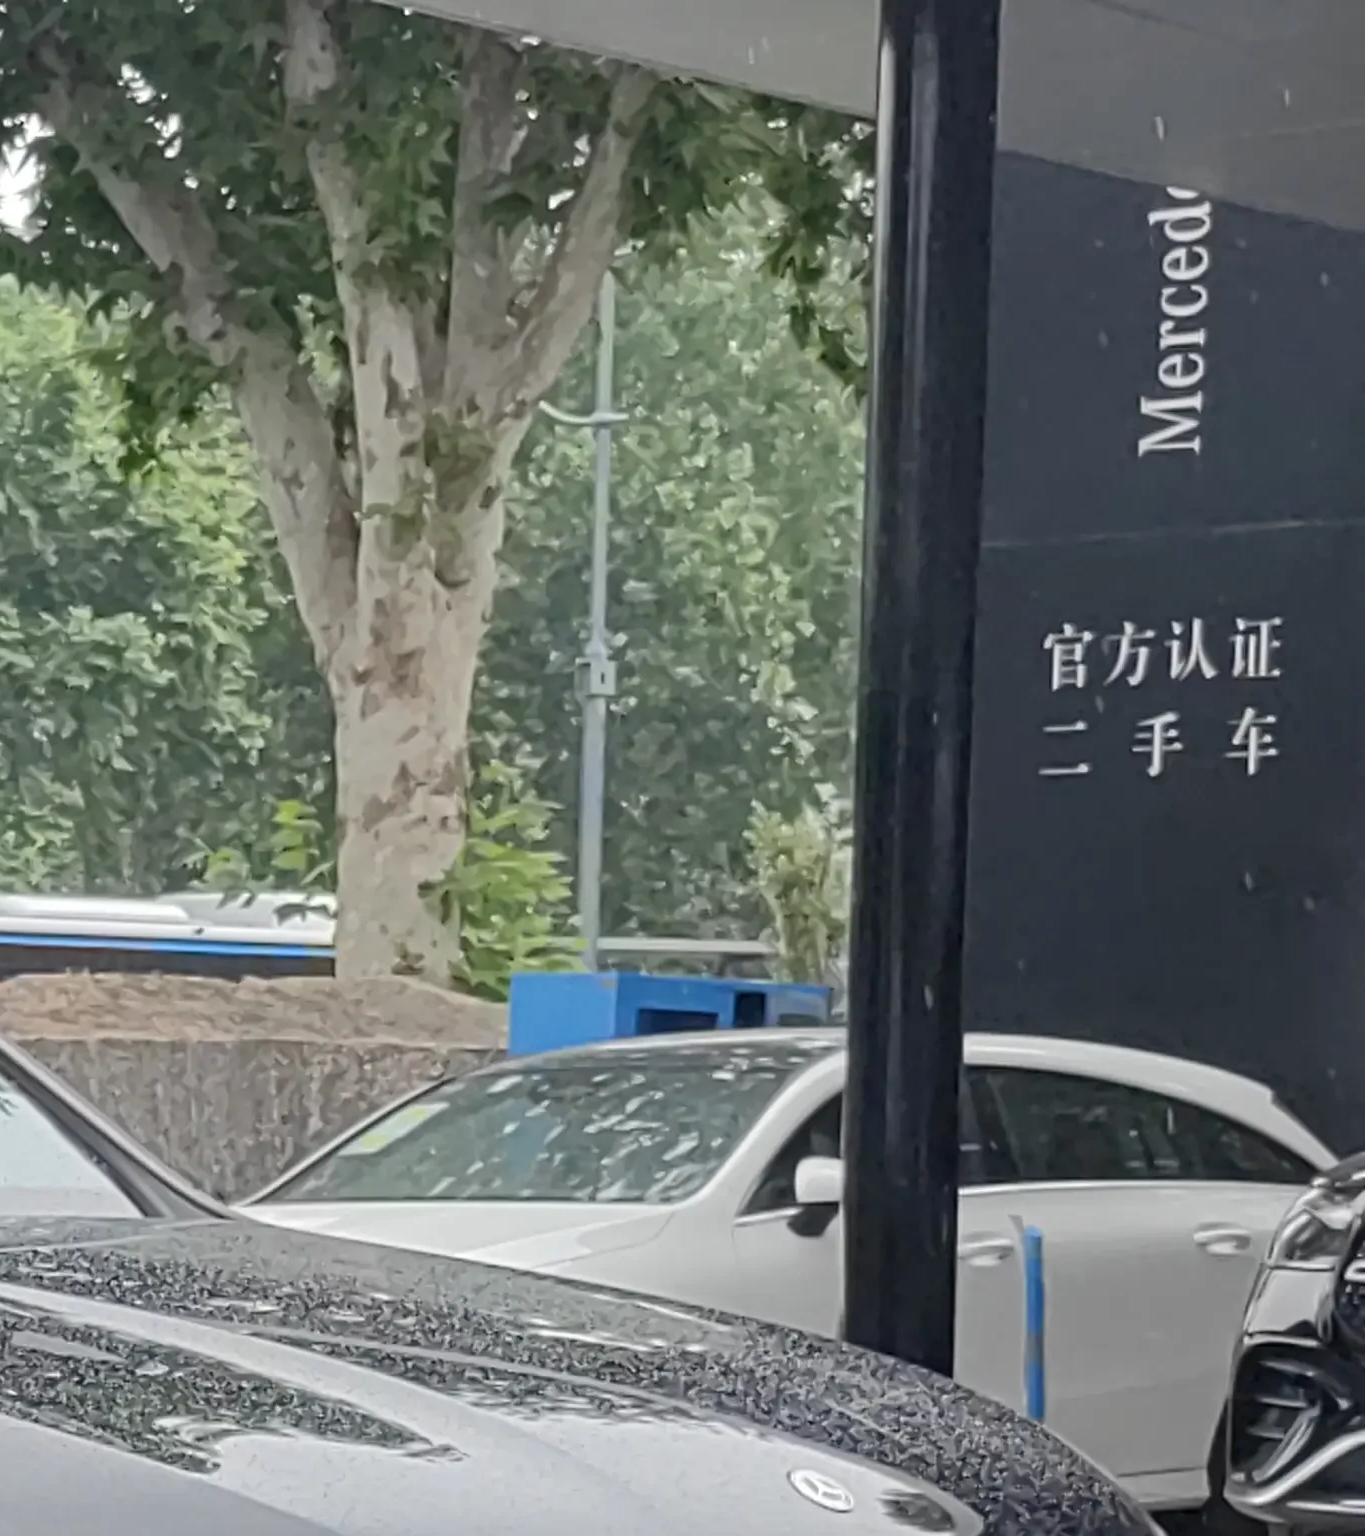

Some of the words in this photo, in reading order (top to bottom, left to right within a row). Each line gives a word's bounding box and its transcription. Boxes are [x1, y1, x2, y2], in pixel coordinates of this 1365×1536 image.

[1042, 616, 1283, 692] 官方认证
[1037, 706, 1280, 777] 二手车
